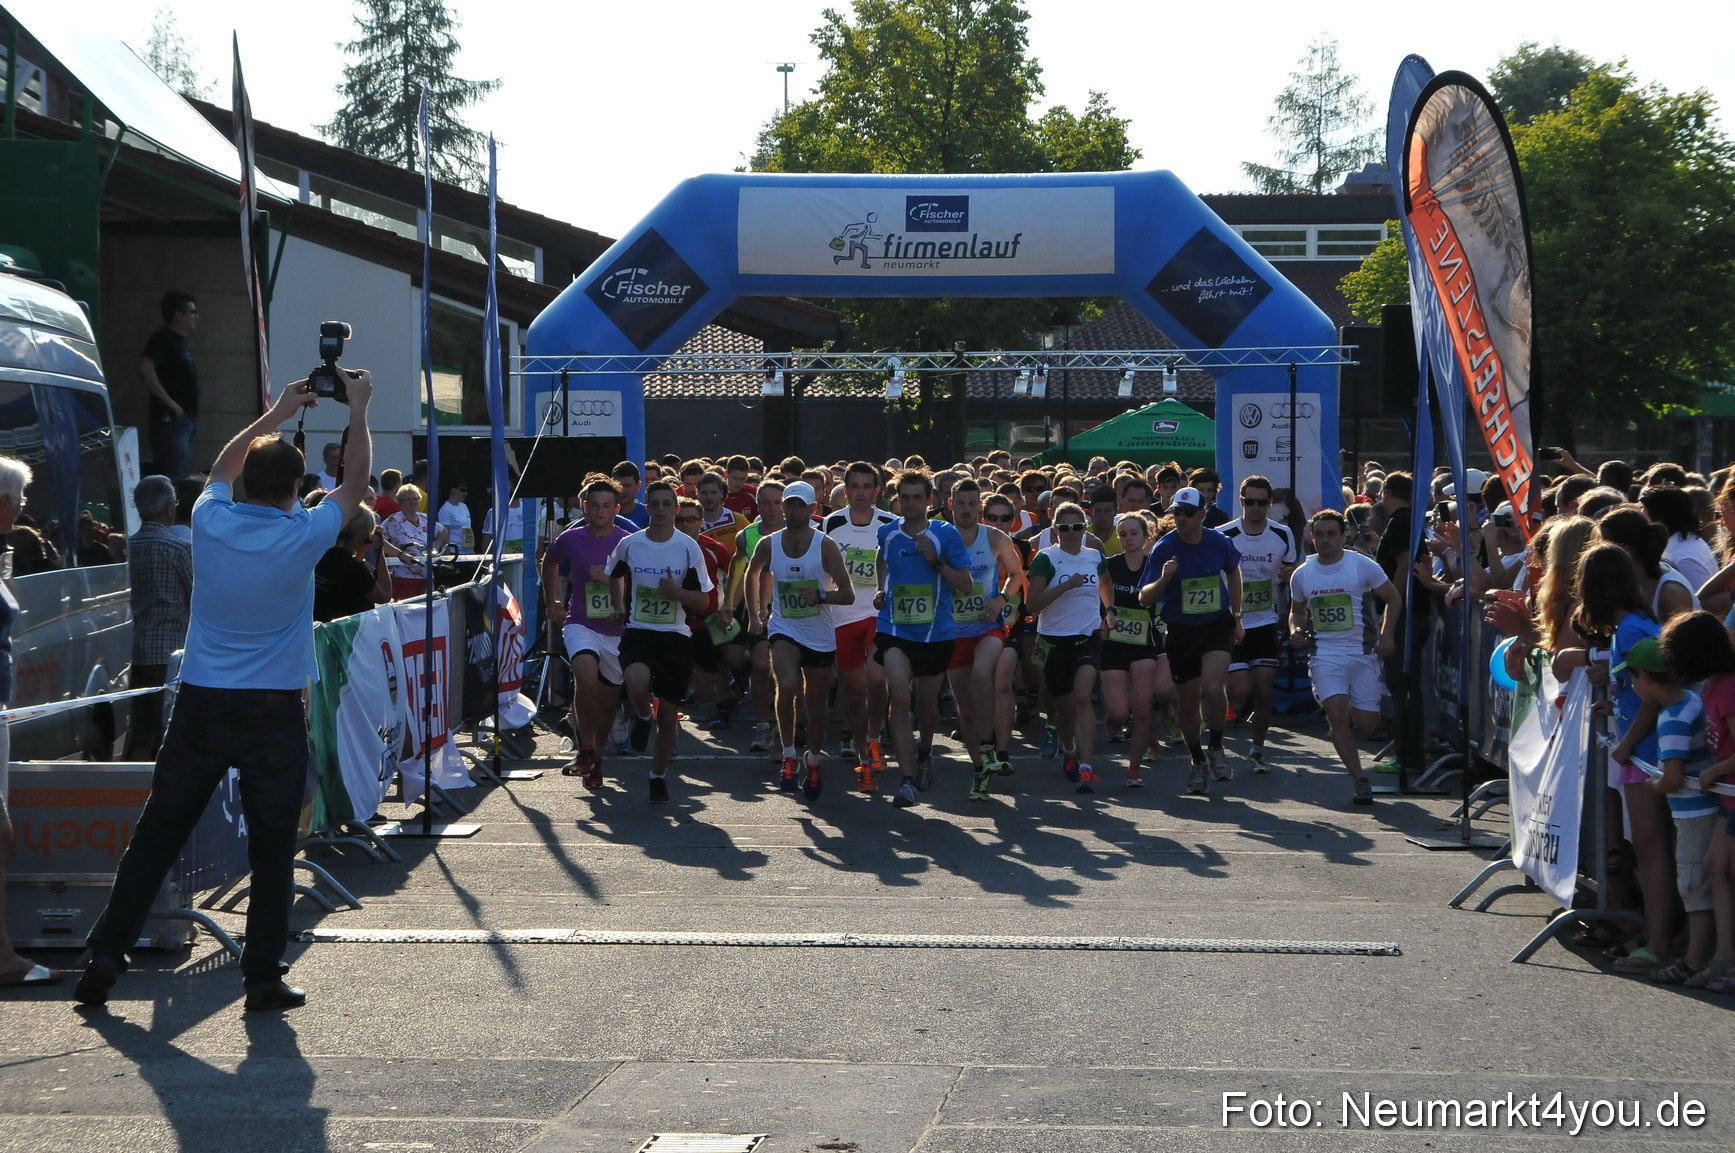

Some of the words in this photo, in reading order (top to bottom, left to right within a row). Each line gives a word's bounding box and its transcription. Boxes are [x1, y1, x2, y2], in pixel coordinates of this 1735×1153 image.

[919, 208, 965, 219] Fischer
[883, 233, 1023, 258] firmenlauf
[883, 260, 941, 269] neumarkt
[616, 280, 691, 296] Fischer
[1171, 279, 1192, 292] und
[1194, 276, 1214, 288] das
[1214, 275, 1256, 287] Lächeln
[622, 296, 685, 304] AUTOMOBILE
[1197, 289, 1226, 304] fährt
[1229, 286, 1254, 296] mit!
[1118, 440, 1207, 448] Lammsbräu
[1244, 444, 1257, 455] FIAT
[634, 566, 681, 576] DELPHI
[846, 560, 875, 578] 143
[1187, 589, 1214, 605] 721
[1245, 590, 1271, 605] 433
[640, 598, 671, 615] 212
[897, 597, 927, 614] 476
[1318, 607, 1346, 623] 558
